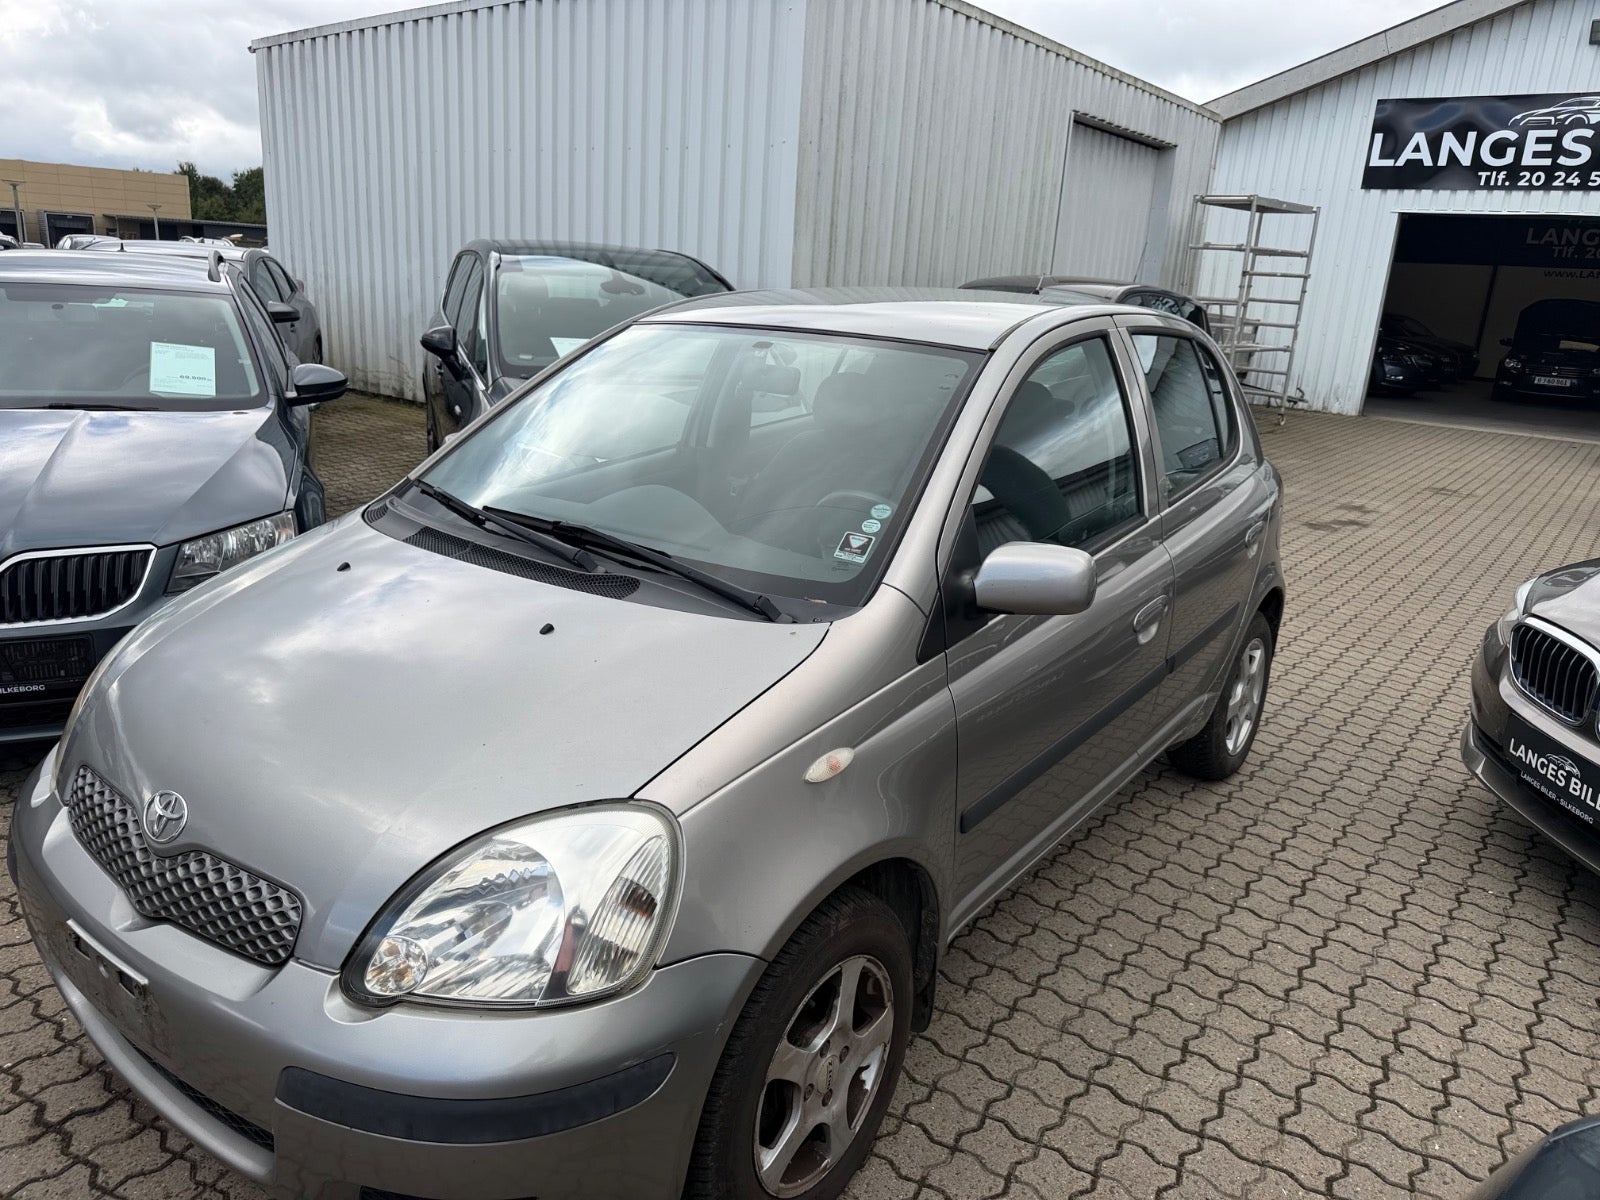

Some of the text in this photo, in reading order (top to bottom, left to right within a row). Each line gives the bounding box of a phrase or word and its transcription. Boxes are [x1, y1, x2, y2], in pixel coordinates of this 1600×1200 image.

[1369, 128, 1595, 167] LANGES
[1477, 171, 1510, 186] Tlf.
[1517, 171, 1546, 186] 20
[1552, 171, 1581, 187] 24
[1509, 737, 1567, 787] LANGES
[1520, 770, 1541, 789] LANGES
[1540, 785, 1557, 801] BILER
[1560, 798, 1594, 824] SILKEBORG
